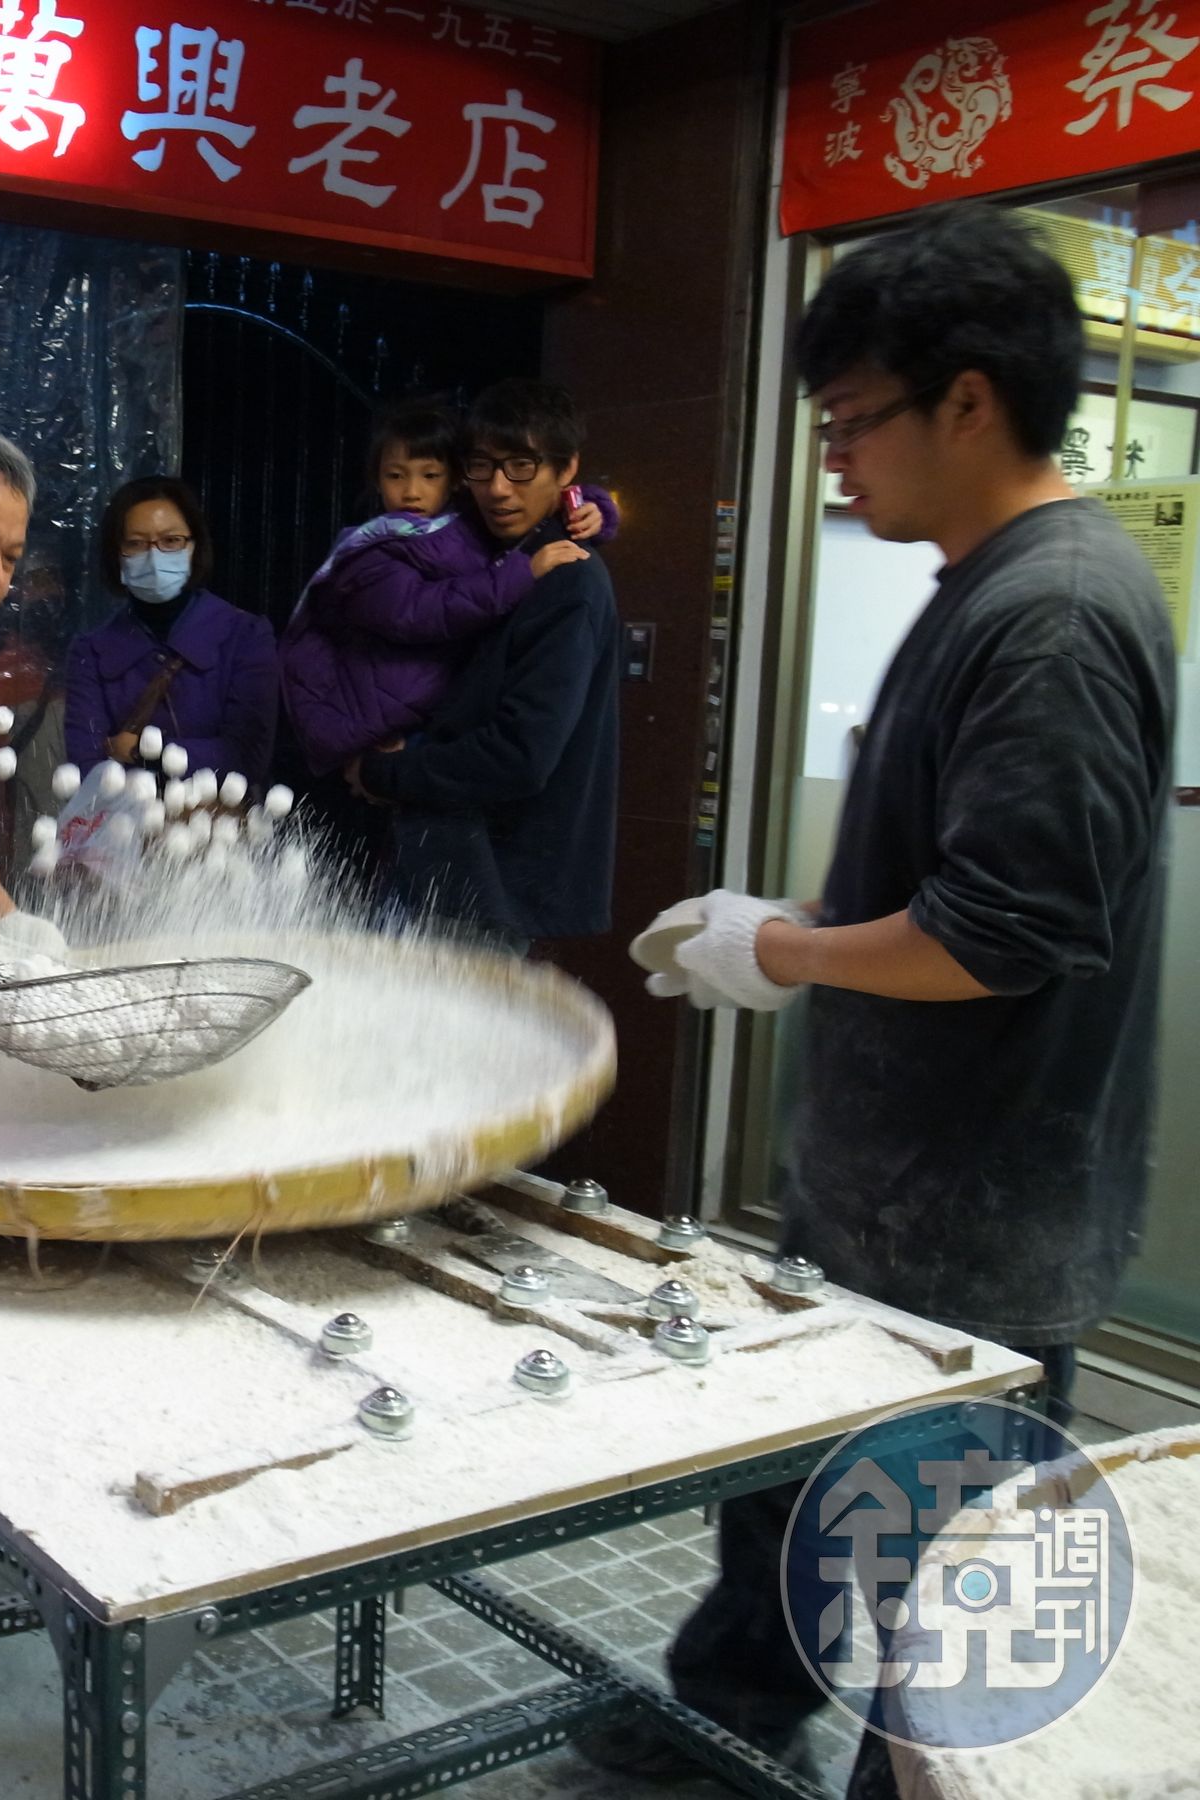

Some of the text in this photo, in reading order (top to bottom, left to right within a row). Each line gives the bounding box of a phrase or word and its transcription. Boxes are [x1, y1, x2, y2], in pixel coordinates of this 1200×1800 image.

[249, 0, 563, 64] 於一九五三
